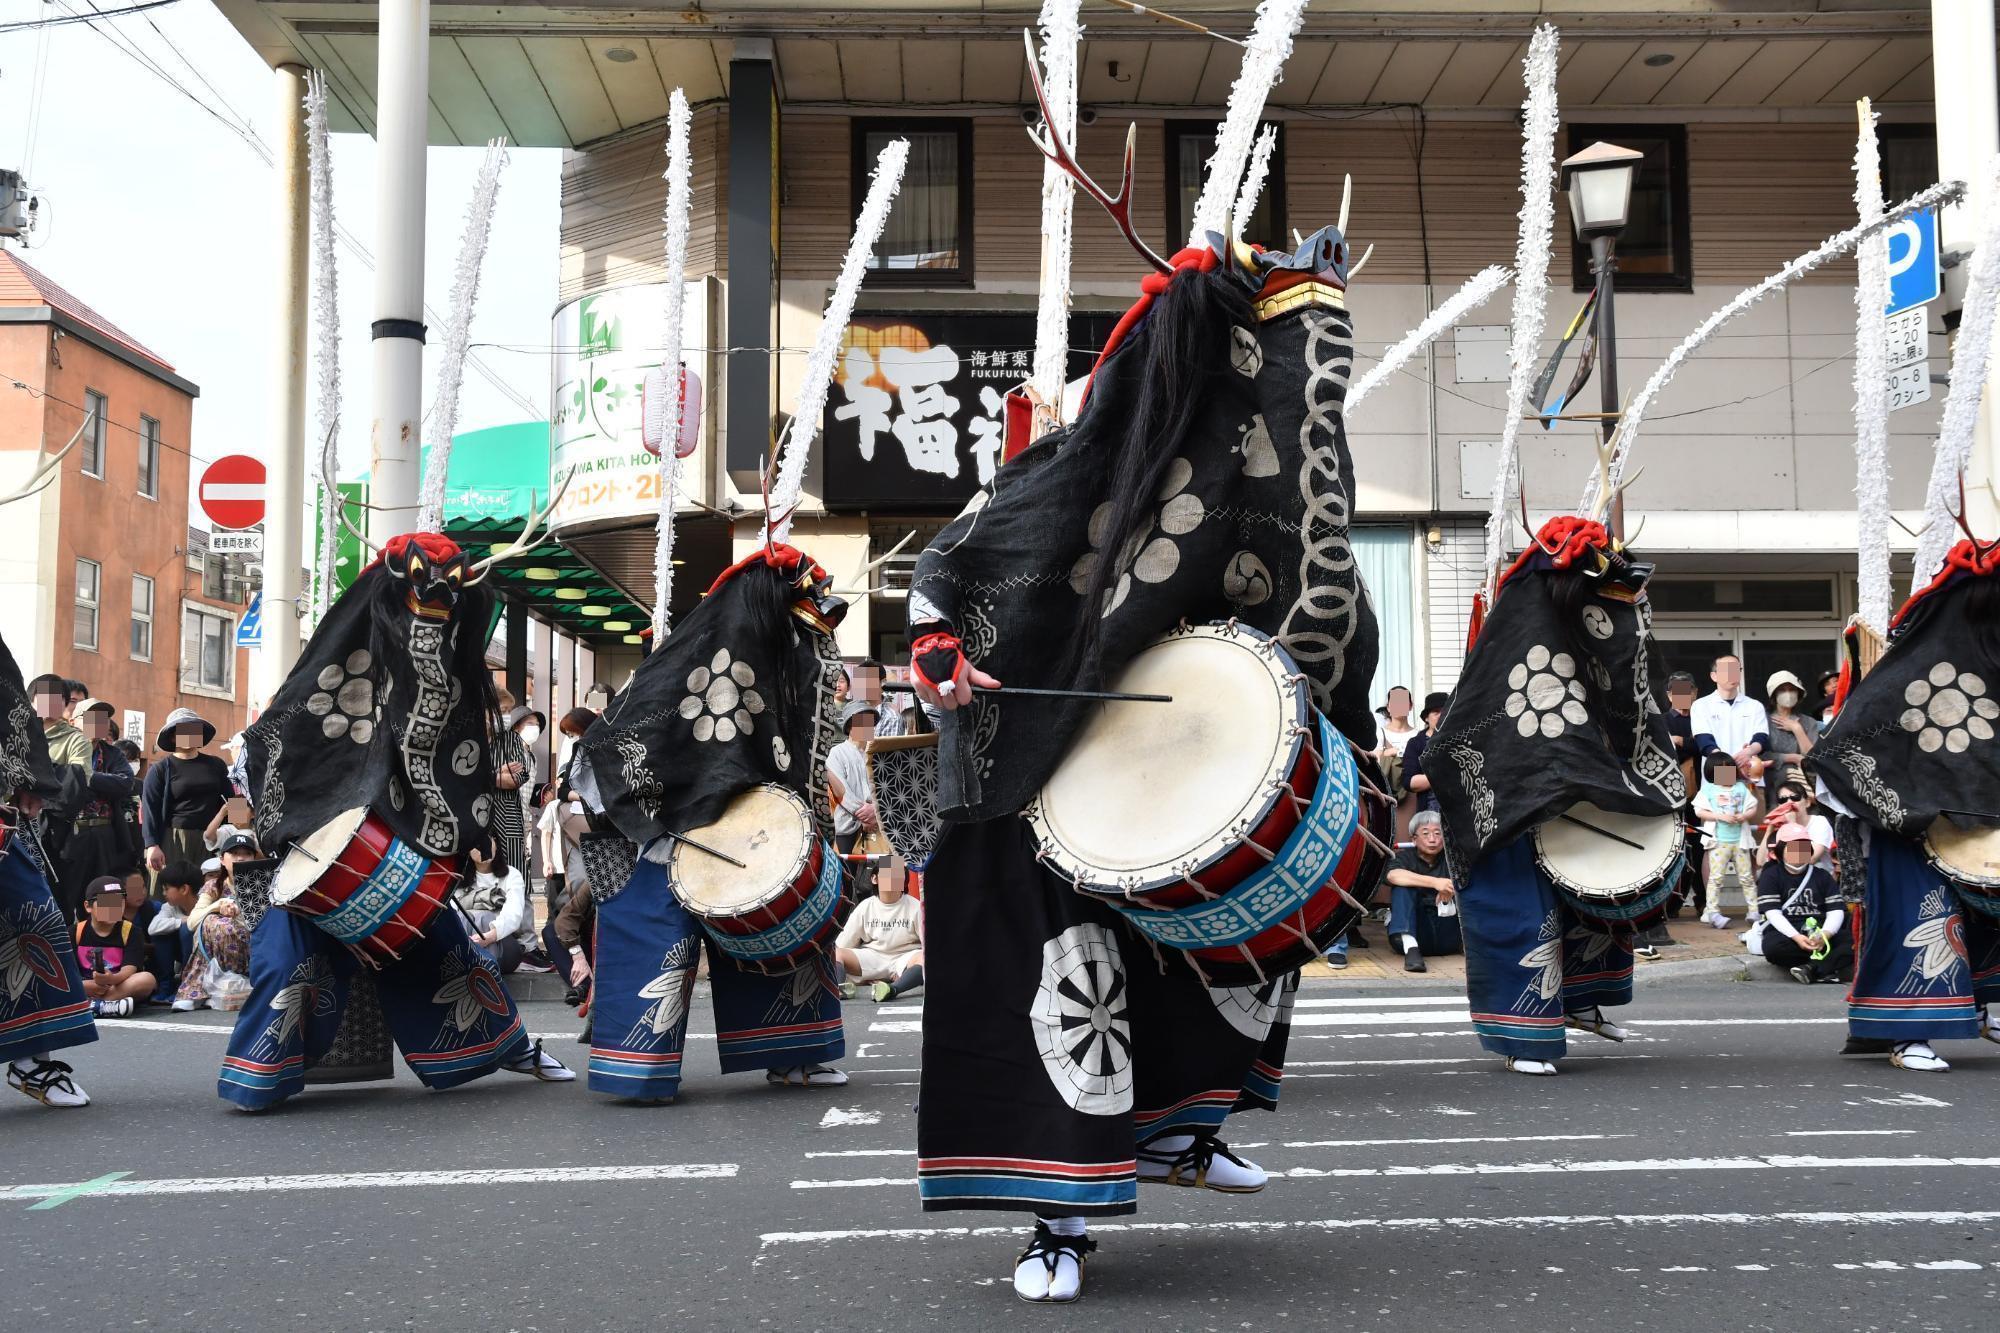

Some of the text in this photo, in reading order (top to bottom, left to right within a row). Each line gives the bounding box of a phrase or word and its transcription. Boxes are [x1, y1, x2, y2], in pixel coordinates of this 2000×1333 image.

[1884, 219, 1922, 305] P
[597, 455, 626, 471] KITA
[213, 537, 259, 549] 軽車両を除く
